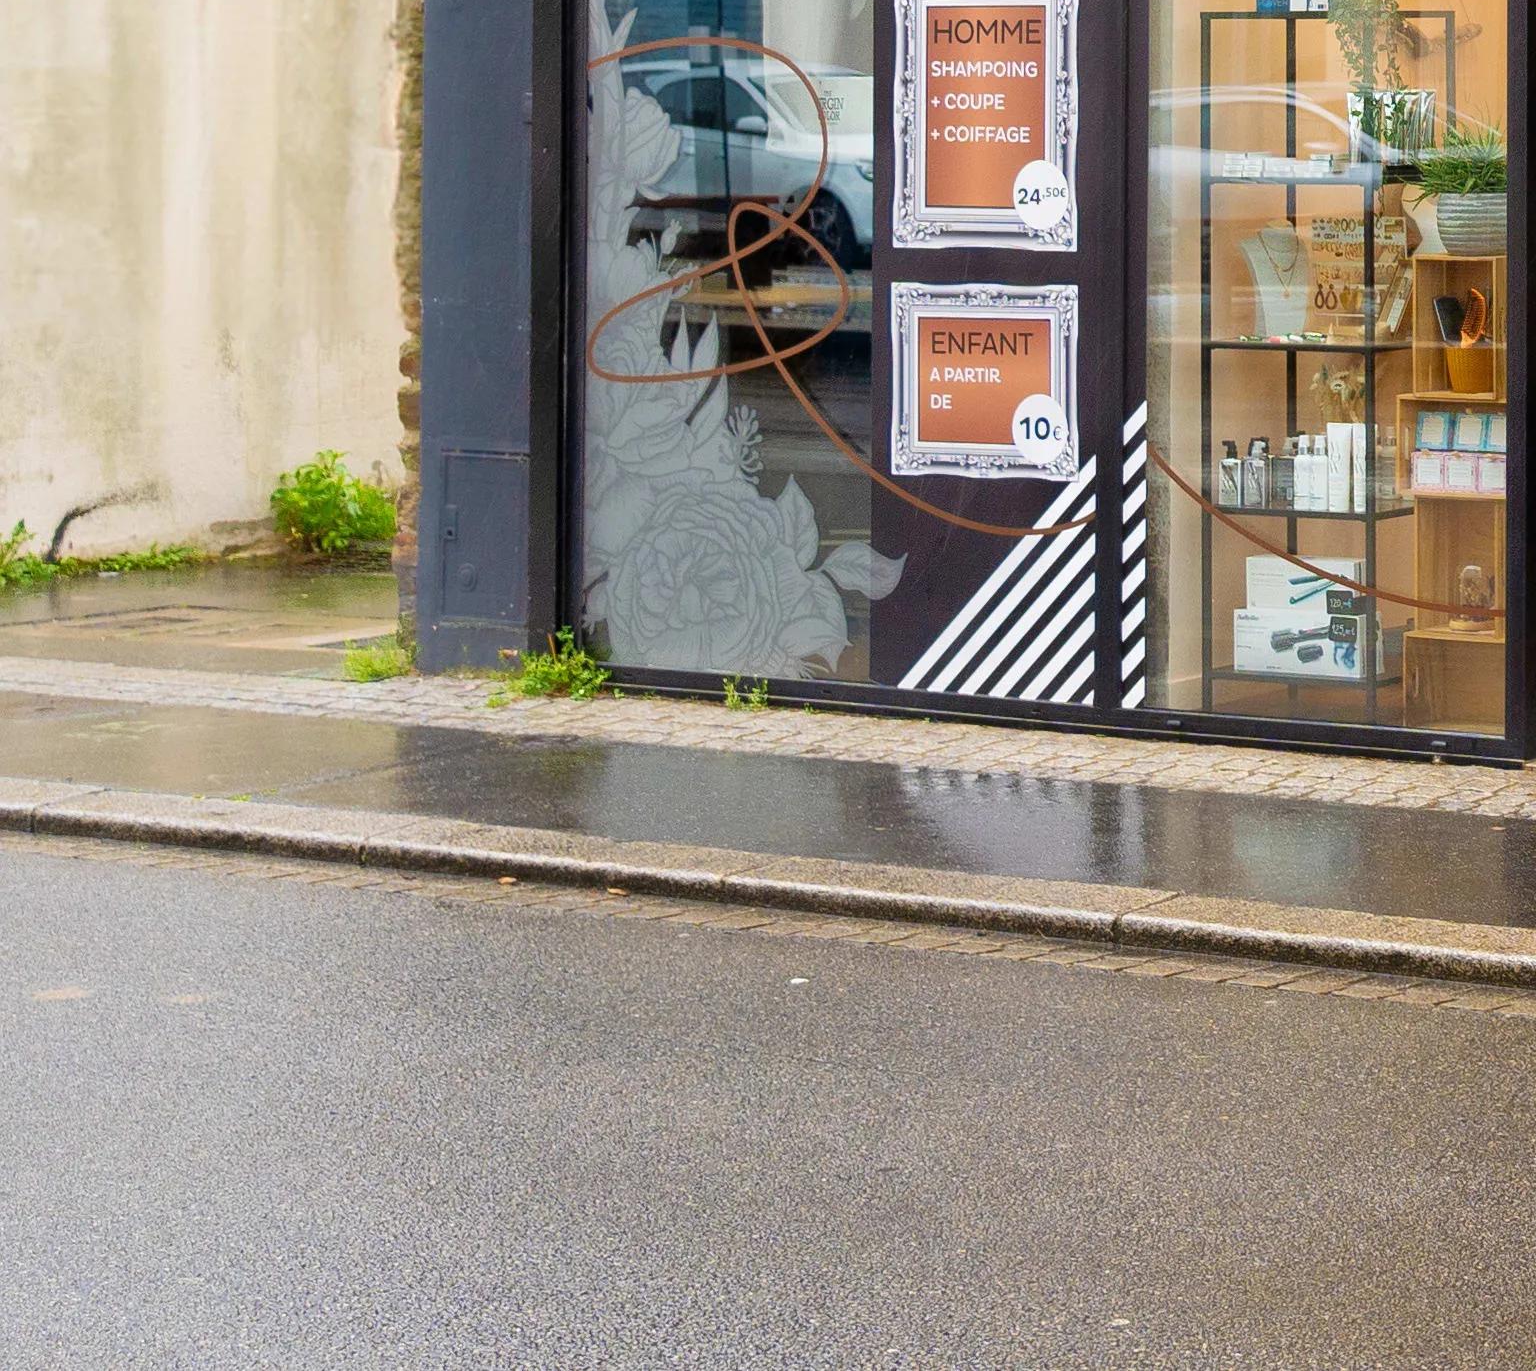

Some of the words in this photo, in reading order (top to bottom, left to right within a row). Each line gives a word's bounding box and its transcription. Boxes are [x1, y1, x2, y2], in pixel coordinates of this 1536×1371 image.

[934, 18, 1042, 45] HOMME
[930, 60, 1039, 78] SHAMPOING
[944, 92, 1006, 110] COUPE
[944, 125, 1032, 144] COIFFAGE
[930, 331, 1034, 356] ENFANT
[929, 366, 940, 383] A
[944, 366, 1002, 384] PARTIR
[929, 394, 953, 410] DE
